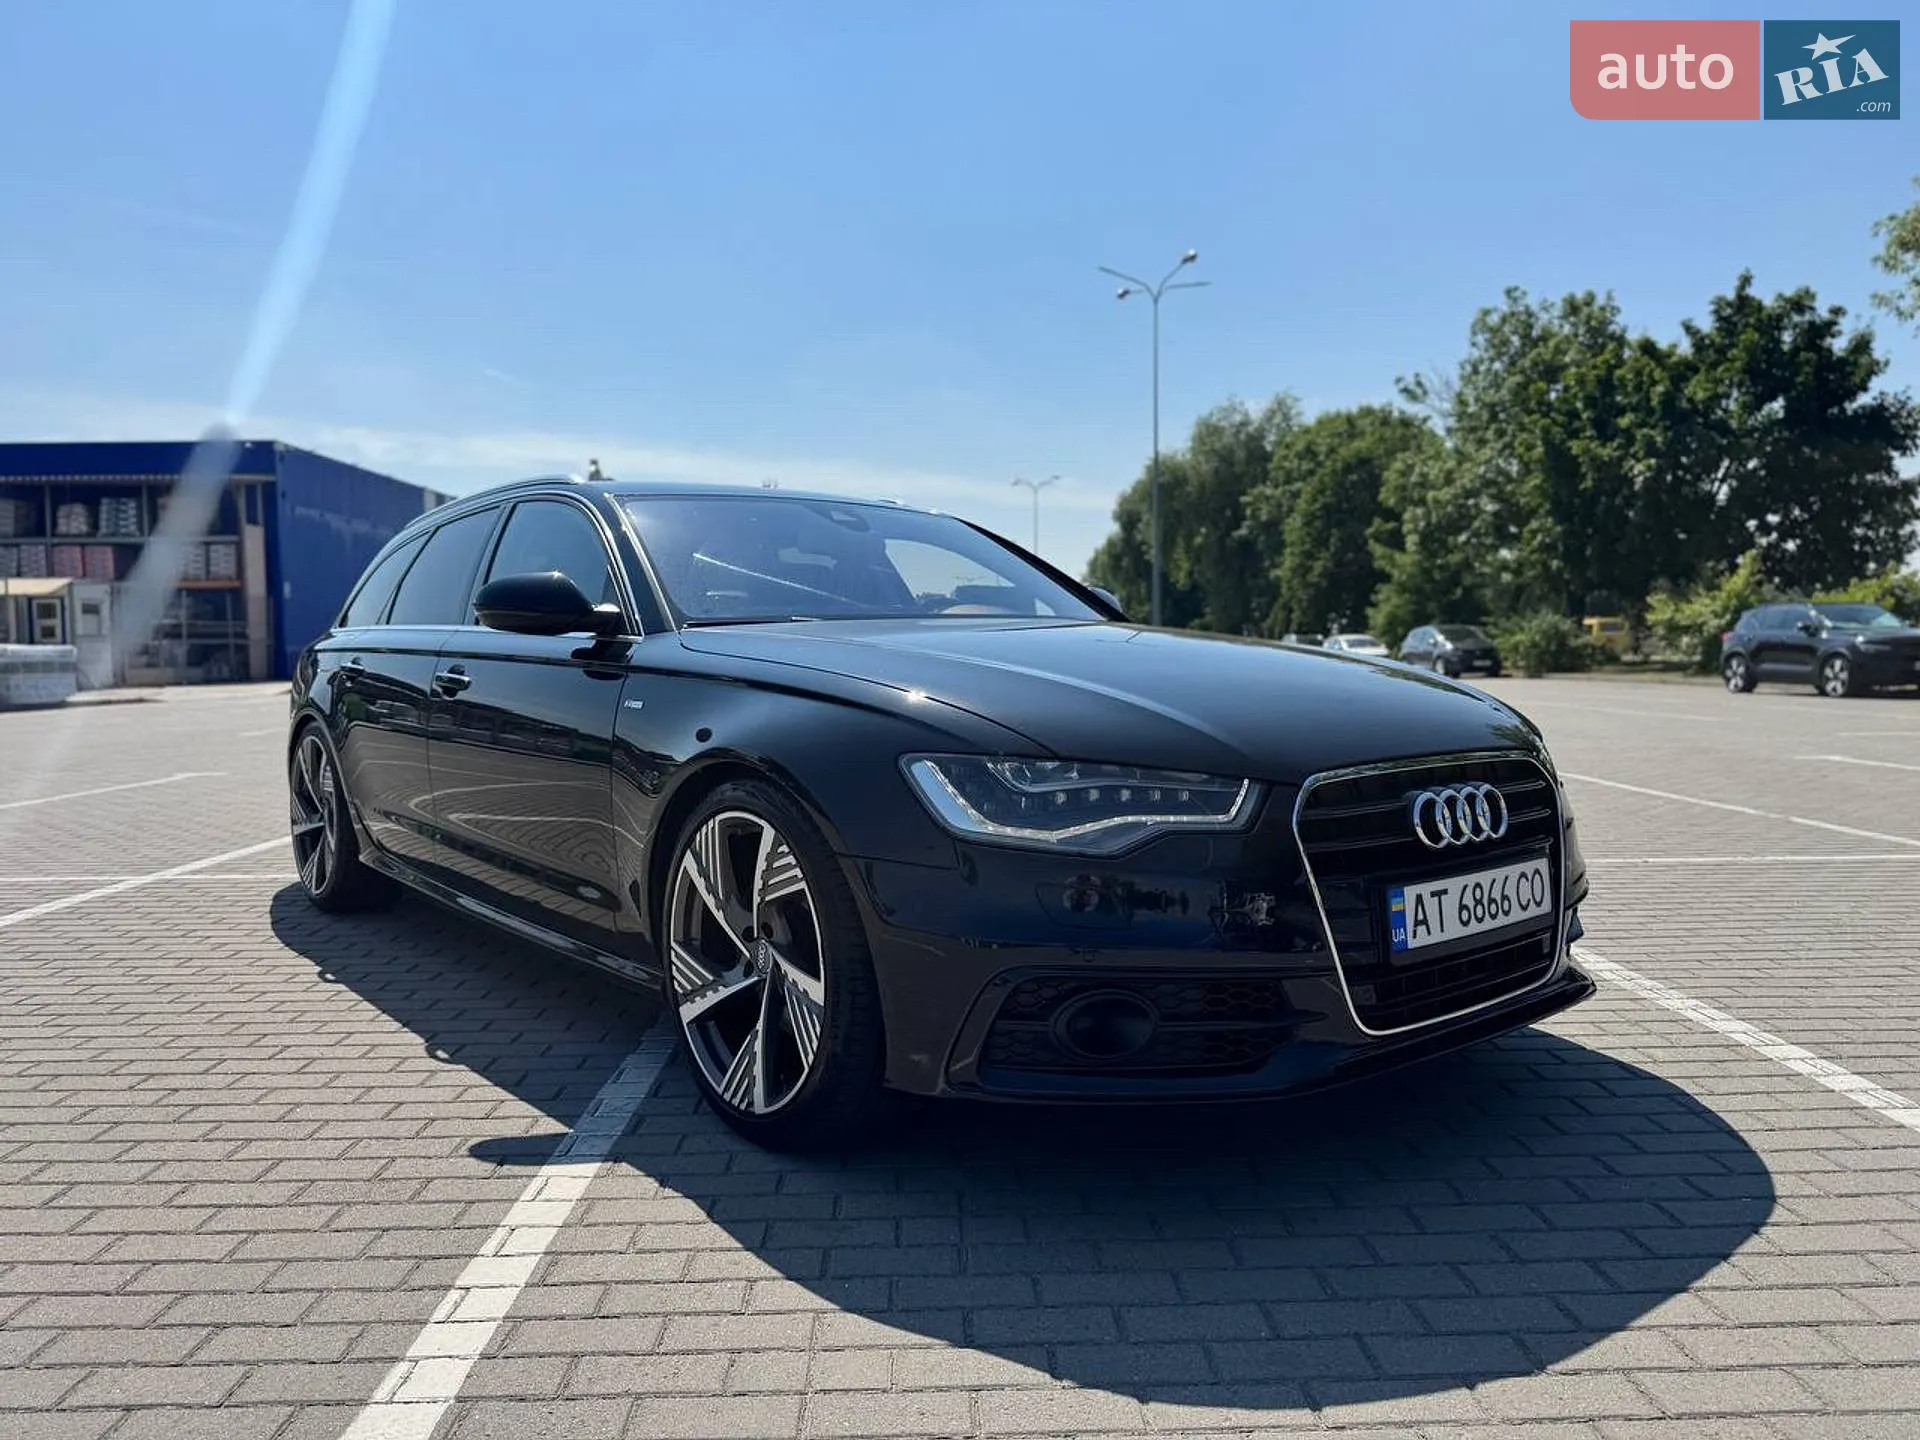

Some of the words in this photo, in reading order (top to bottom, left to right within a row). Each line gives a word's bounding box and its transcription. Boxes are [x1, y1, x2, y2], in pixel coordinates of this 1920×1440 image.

[1412, 888, 1449, 940] AT
[1458, 874, 1512, 928] 6866
[1516, 867, 1545, 912] CO
[1391, 927, 1407, 943] UA
